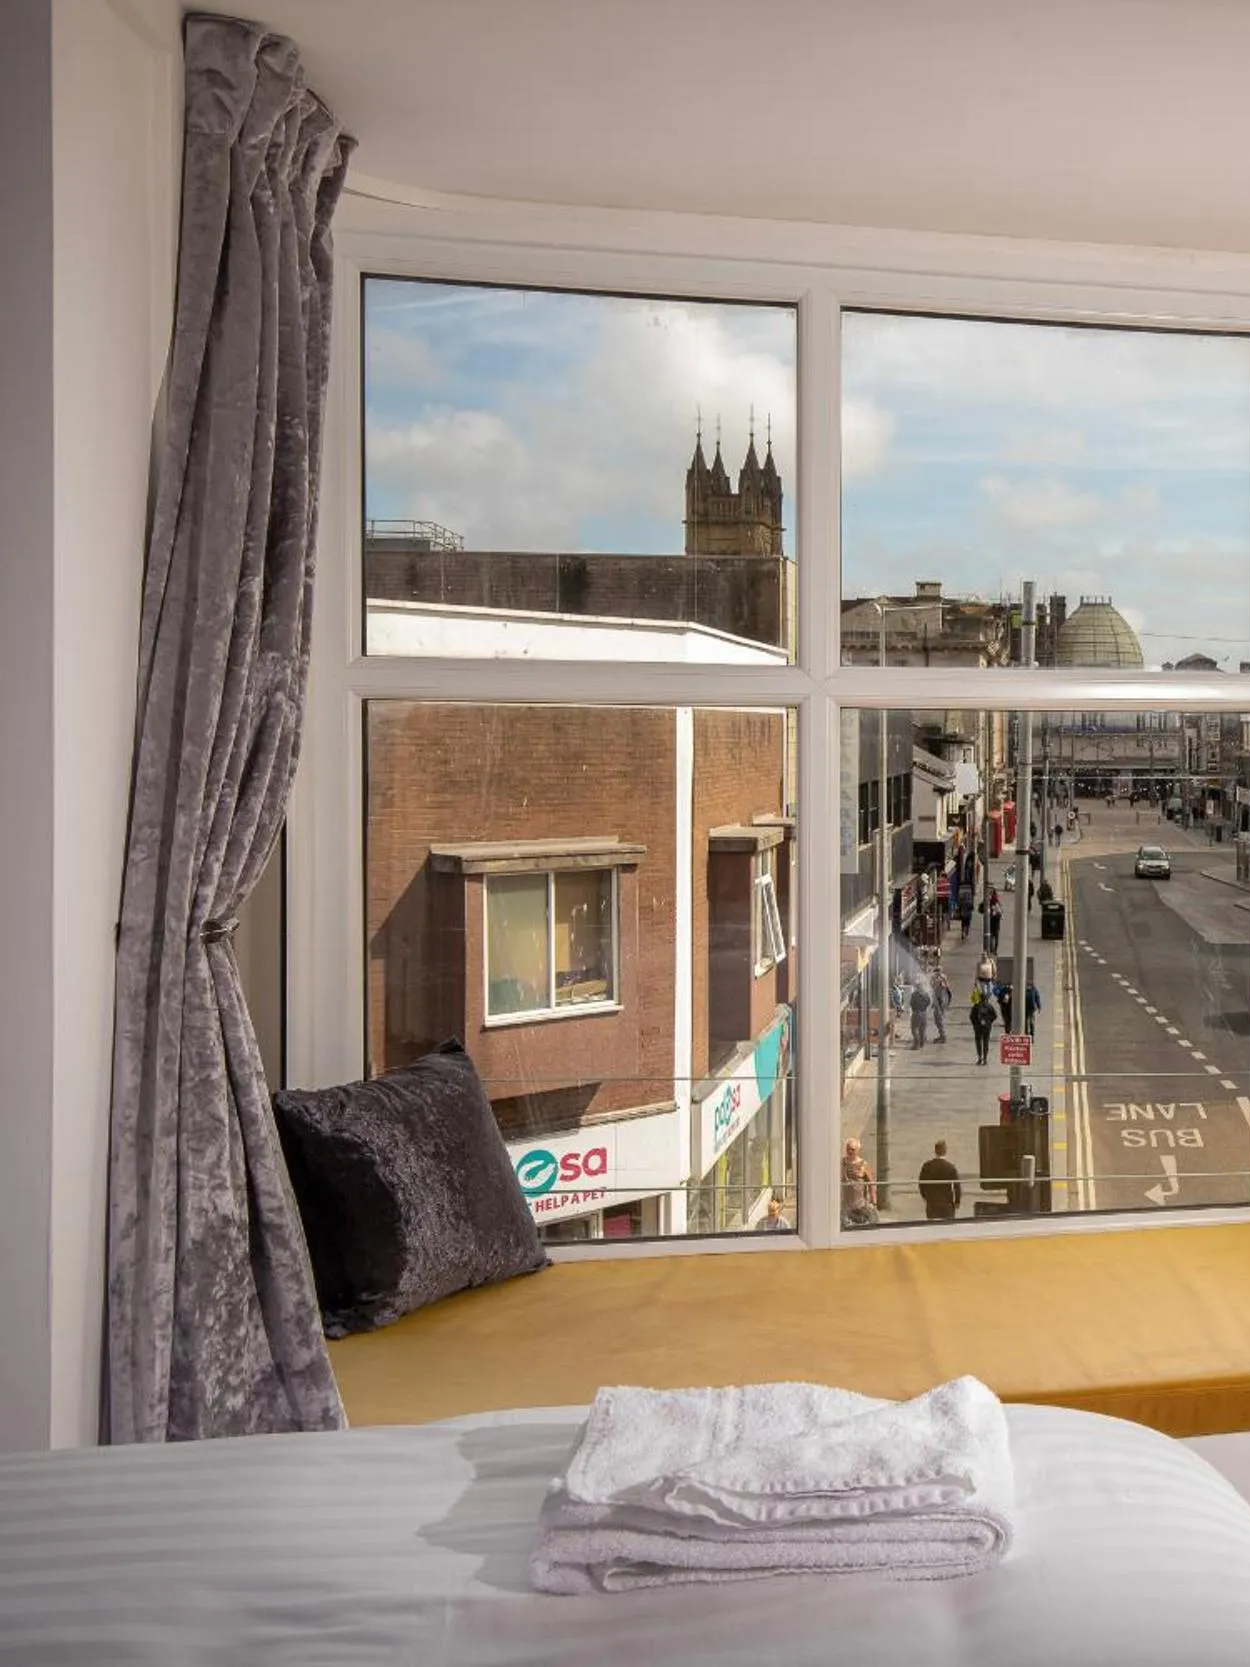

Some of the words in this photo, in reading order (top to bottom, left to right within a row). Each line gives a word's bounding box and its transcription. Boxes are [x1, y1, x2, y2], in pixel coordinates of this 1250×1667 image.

[1103, 1103, 1207, 1121] LANE
[1120, 1128, 1204, 1148] BUS
[535, 1195, 569, 1213] HELP
[571, 1192, 580, 1205] A
[583, 1187, 607, 1202] PET
